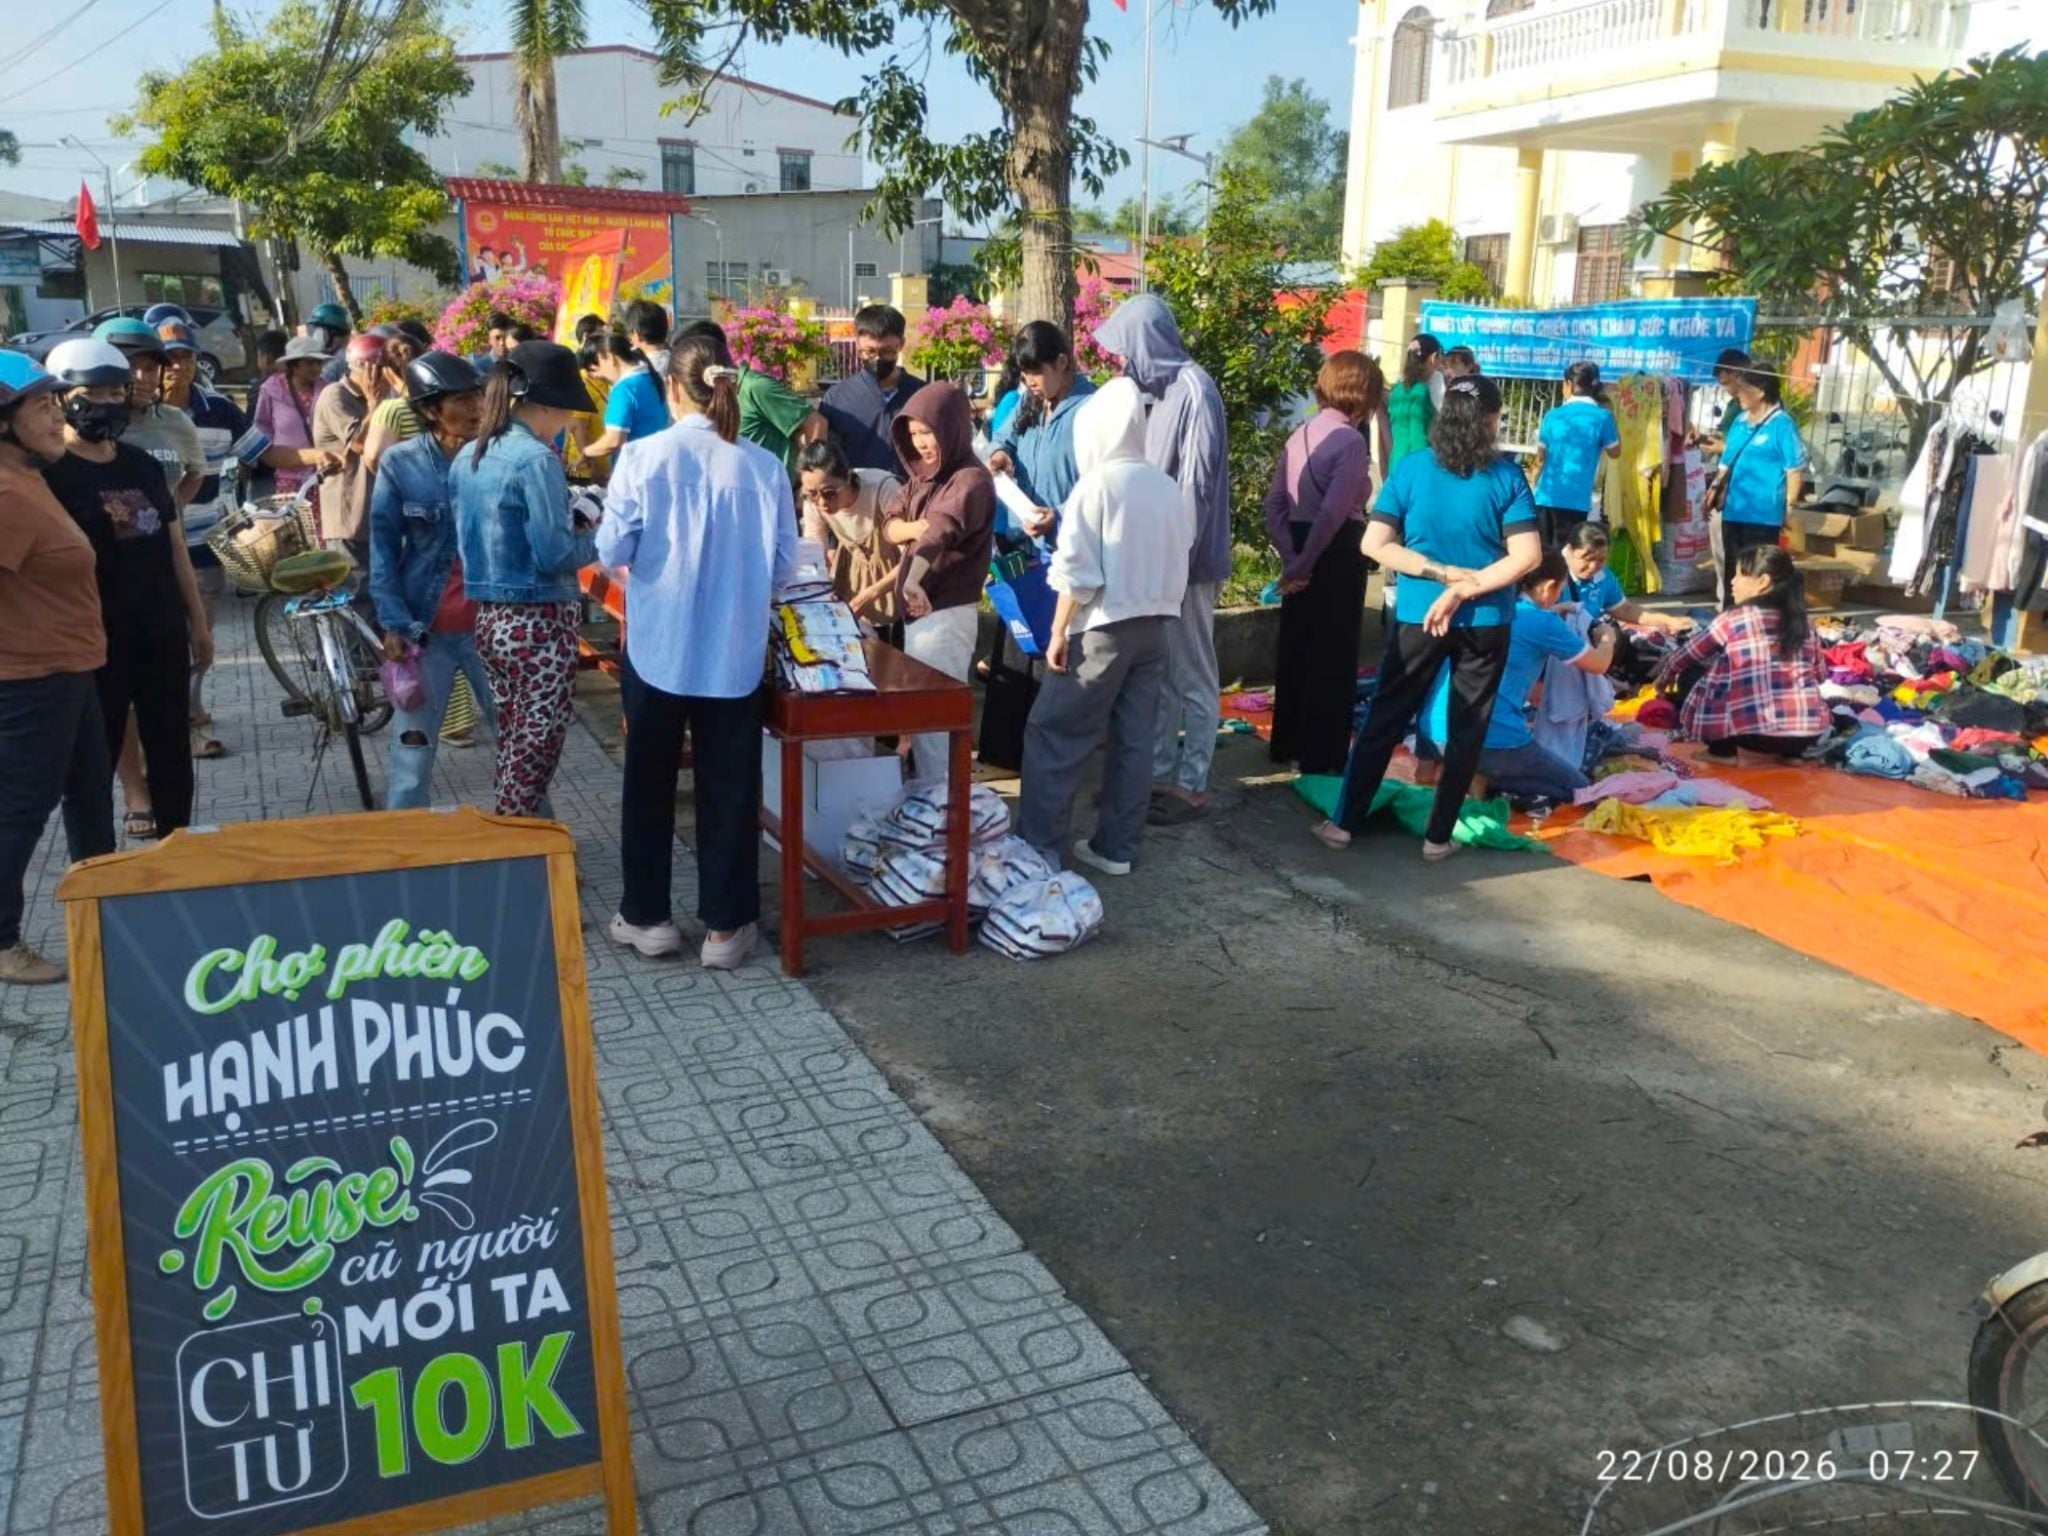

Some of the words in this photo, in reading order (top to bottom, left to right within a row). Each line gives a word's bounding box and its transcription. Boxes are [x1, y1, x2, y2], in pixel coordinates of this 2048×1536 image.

[1639, 314, 1665, 337] SỨC
[1669, 311, 1711, 338] KHỎE
[184, 934, 326, 1014] Chợ
[327, 918, 490, 999] phiên
[163, 1005, 339, 1132] HẠNH
[351, 986, 526, 1084] PHÚC
[340, 1240, 401, 1287] cũ
[416, 1206, 560, 1281] người
[344, 1276, 475, 1356] MỚI
[490, 1268, 572, 1324] TA
[190, 1320, 331, 1428] CHỈ
[350, 1330, 585, 1479] 10K
[215, 1418, 315, 1503] TỪ
